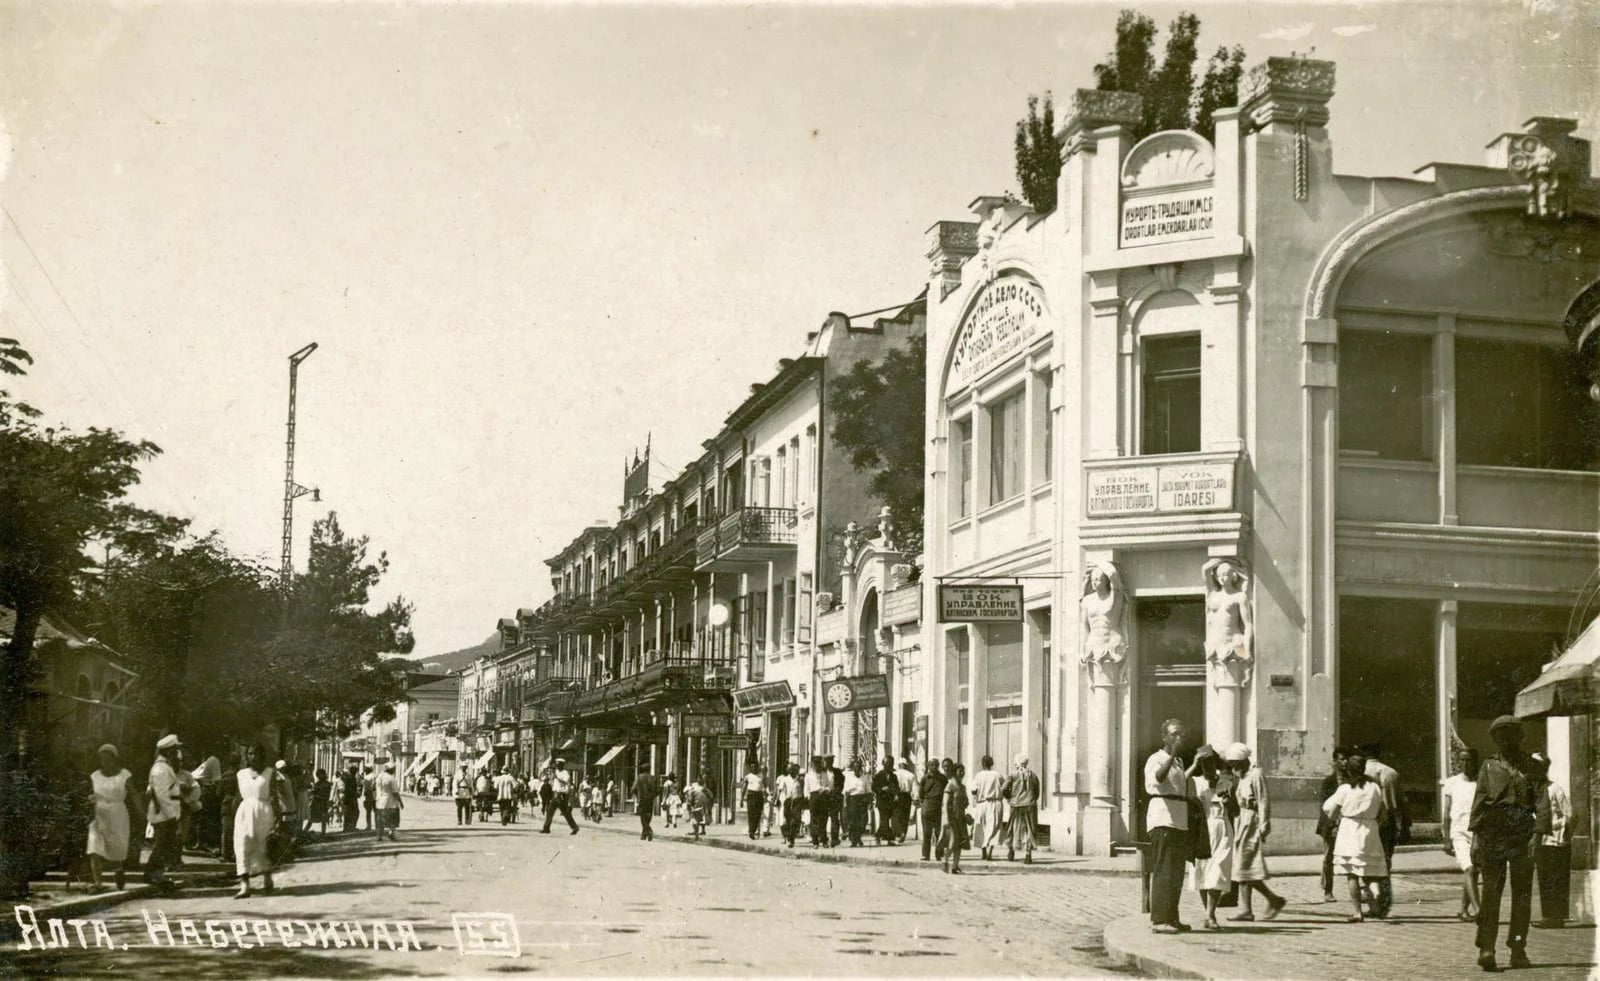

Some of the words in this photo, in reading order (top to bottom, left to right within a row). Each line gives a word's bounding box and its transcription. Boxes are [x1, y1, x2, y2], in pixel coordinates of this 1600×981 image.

[996, 284, 1016, 305] ДЕЛО
[1019, 287, 1042, 318] СССР
[1095, 483, 1150, 496] УПРАВЛЕНИЕ
[1174, 491, 1215, 507] IDARESI
[946, 601, 1017, 609] УПРАВЛЕНИЕ
